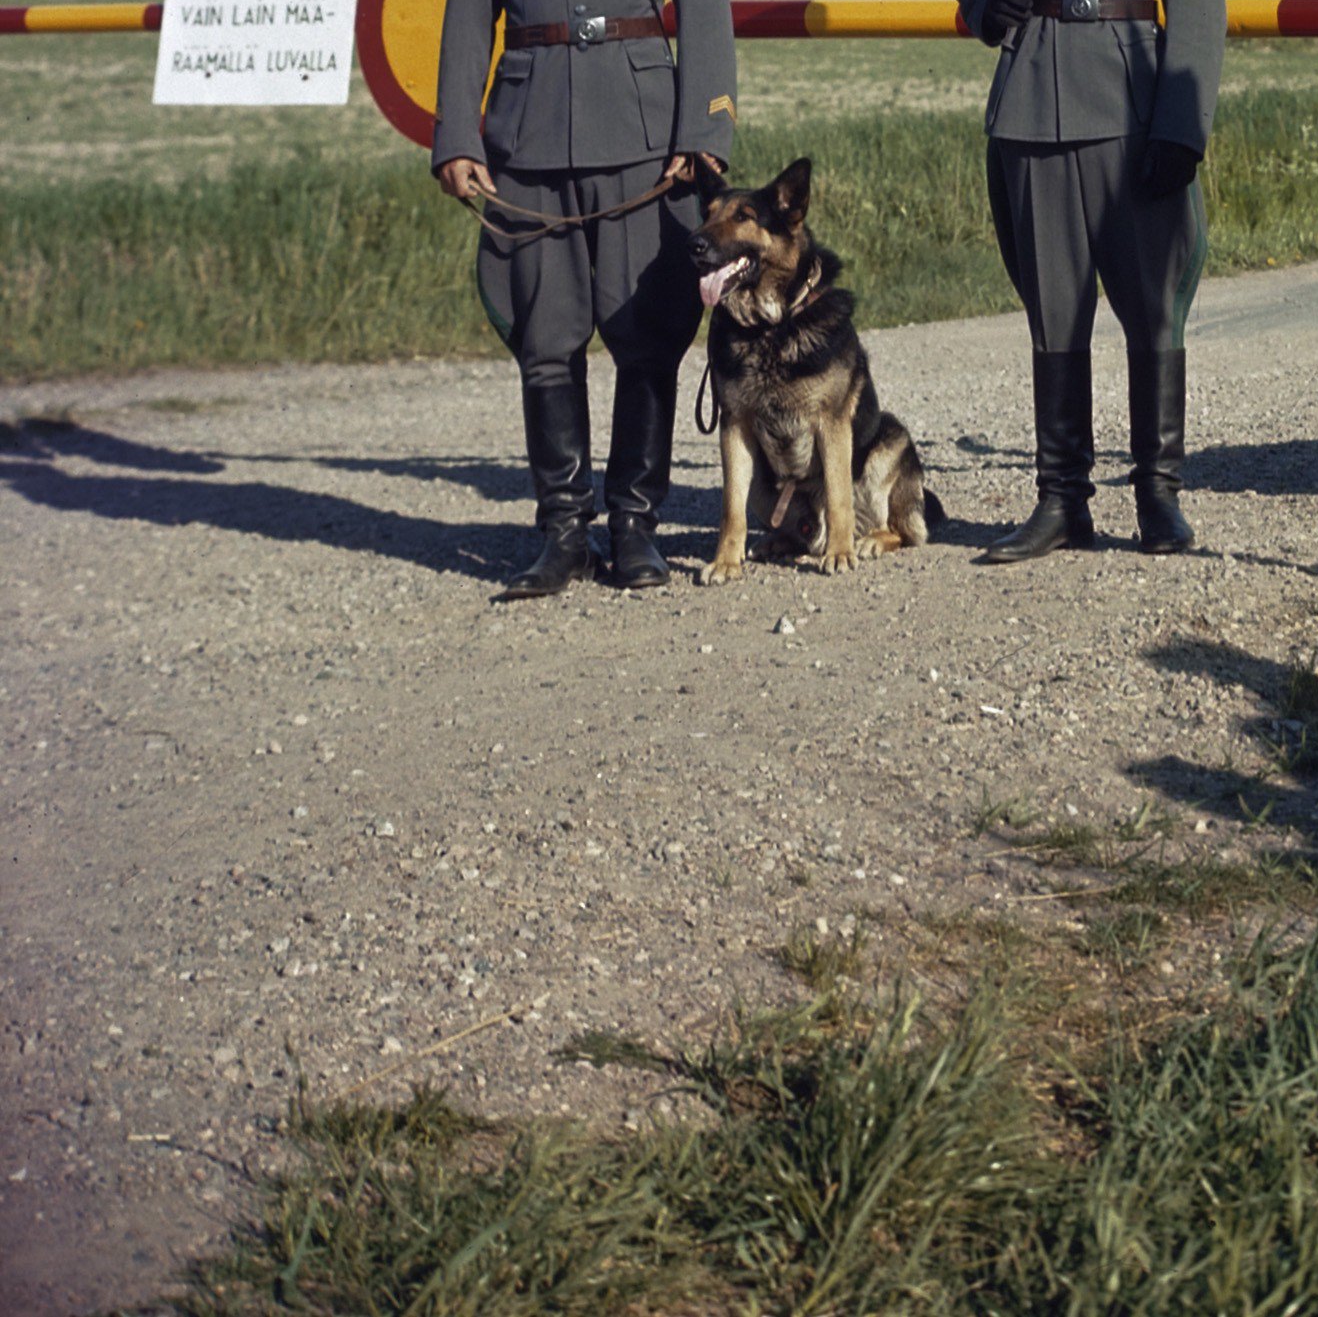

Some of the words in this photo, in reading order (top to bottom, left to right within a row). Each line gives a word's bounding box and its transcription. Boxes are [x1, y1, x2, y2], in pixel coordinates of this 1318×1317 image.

[181, 2, 224, 26] VAIN
[231, 1, 276, 26] LAIN
[266, 49, 338, 73] LUVALLA
